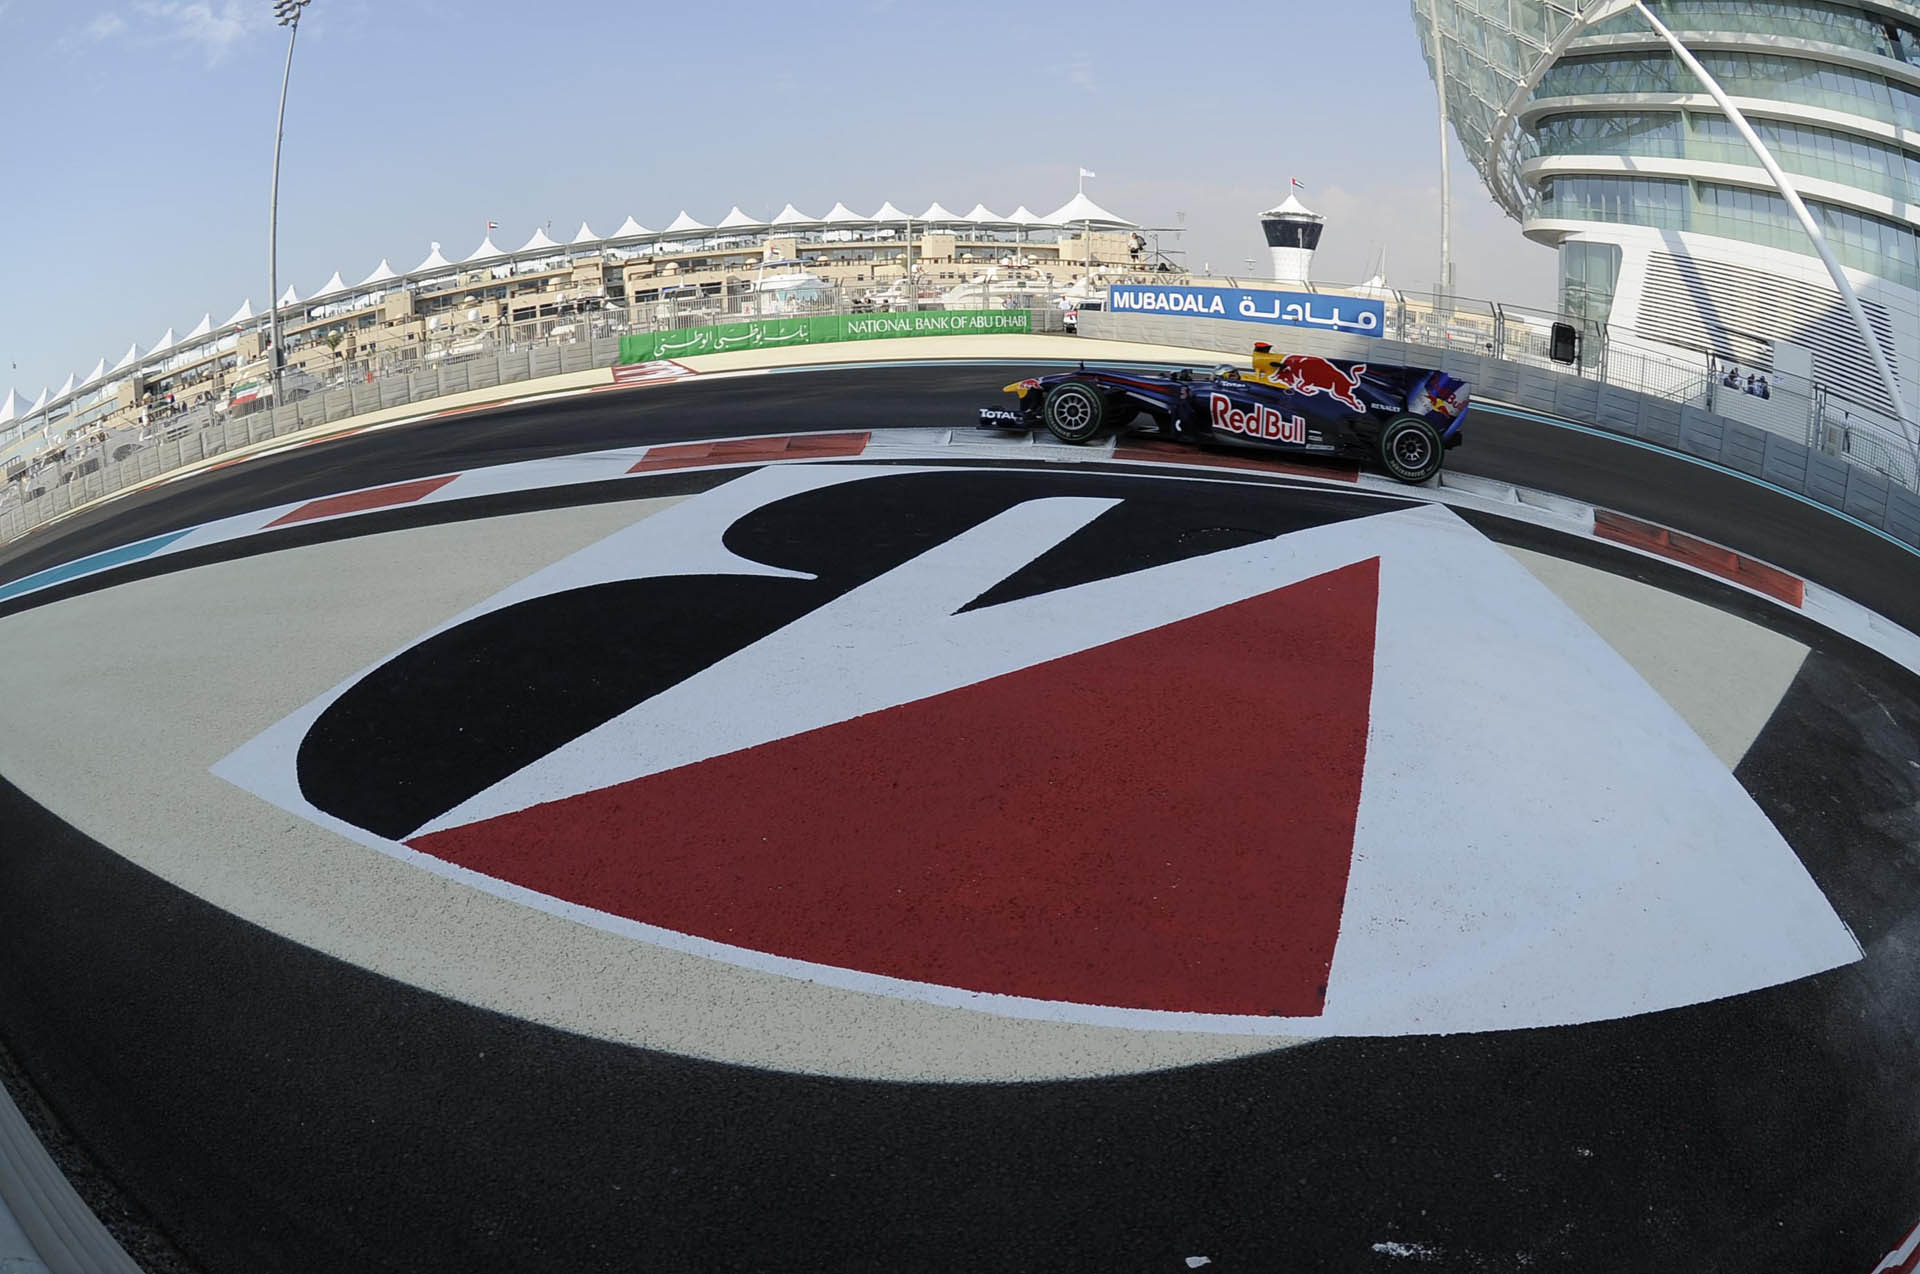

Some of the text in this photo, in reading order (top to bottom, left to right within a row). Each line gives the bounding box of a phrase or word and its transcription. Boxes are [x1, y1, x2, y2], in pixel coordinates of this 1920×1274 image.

[1113, 291, 1225, 314] MUBADALA
[1239, 295, 1378, 330] مبادلة
[848, 315, 1027, 333] NATIONAL BANK OF ABU DHABI
[765, 325, 809, 342] بنك
[979, 408, 1017, 421] TOTAL
